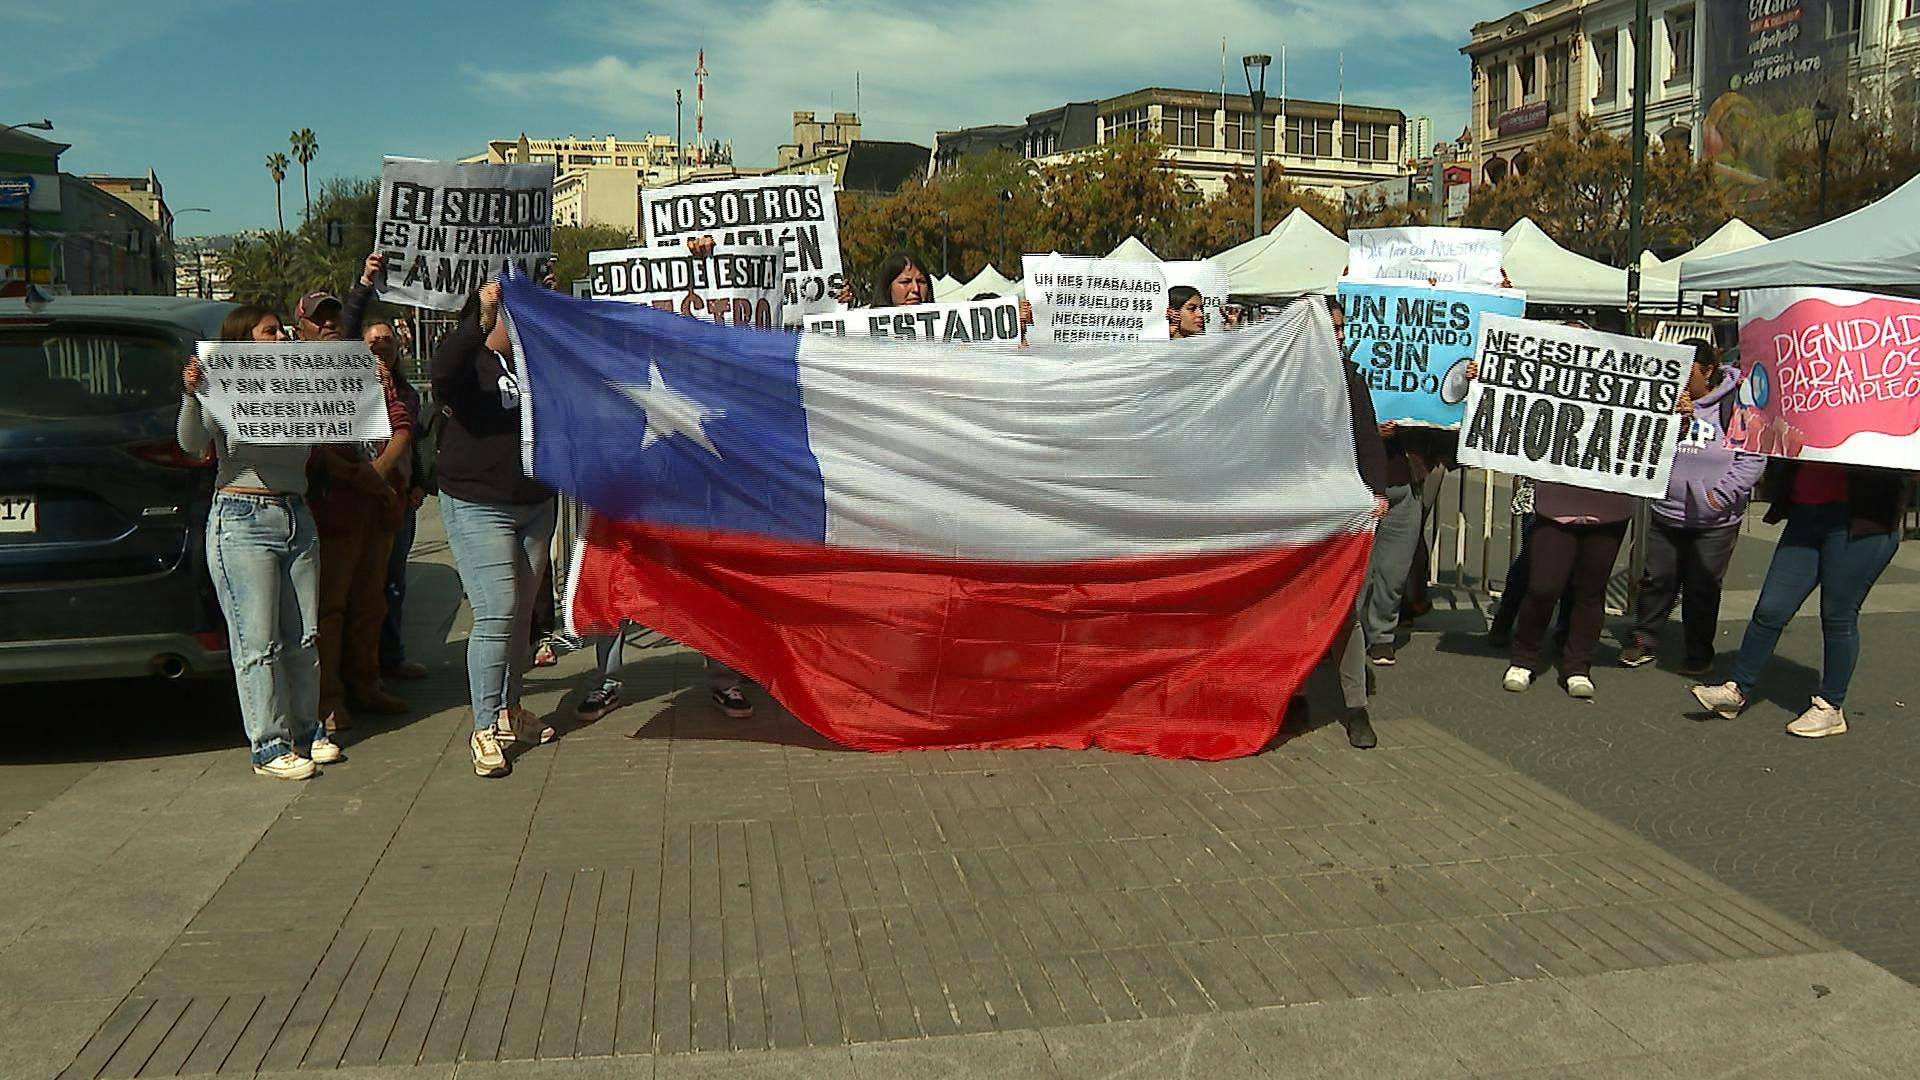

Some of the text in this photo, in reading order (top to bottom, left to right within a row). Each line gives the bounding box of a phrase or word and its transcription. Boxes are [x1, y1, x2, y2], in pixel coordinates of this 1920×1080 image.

[395, 184, 545, 225] EL SUELDO
[654, 187, 823, 235] NOSOTROS
[379, 221, 552, 255] ES UN PATRIMONIO
[593, 255, 775, 295] ¿DÓNDE ESTÁ
[1035, 273, 1161, 294] UN MES TRABAJADO
[1044, 291, 1153, 313] Y SIN SUELDO $$$
[1339, 293, 1470, 331] UN MES
[868, 304, 1019, 343] ESTADO
[1773, 314, 1920, 367] DIGNIDAD
[207, 354, 374, 370] UN MES TRABAJADO
[1371, 341, 1429, 373] SIN
[1485, 328, 1682, 380] NECESITAMOS
[218, 378, 364, 394] Y SIN SUELDO $$$
[1362, 368, 1439, 394] ELDO
[1482, 352, 1677, 413] RESPUESTAS
[1777, 358, 1853, 396] PARA
[1779, 375, 1920, 416] PROEMPLEO
[231, 401, 357, 419] ¡NECESITAMOS
[236, 421, 353, 438] RESPUESTAS!
[1465, 386, 1669, 480] AHORA!!!
